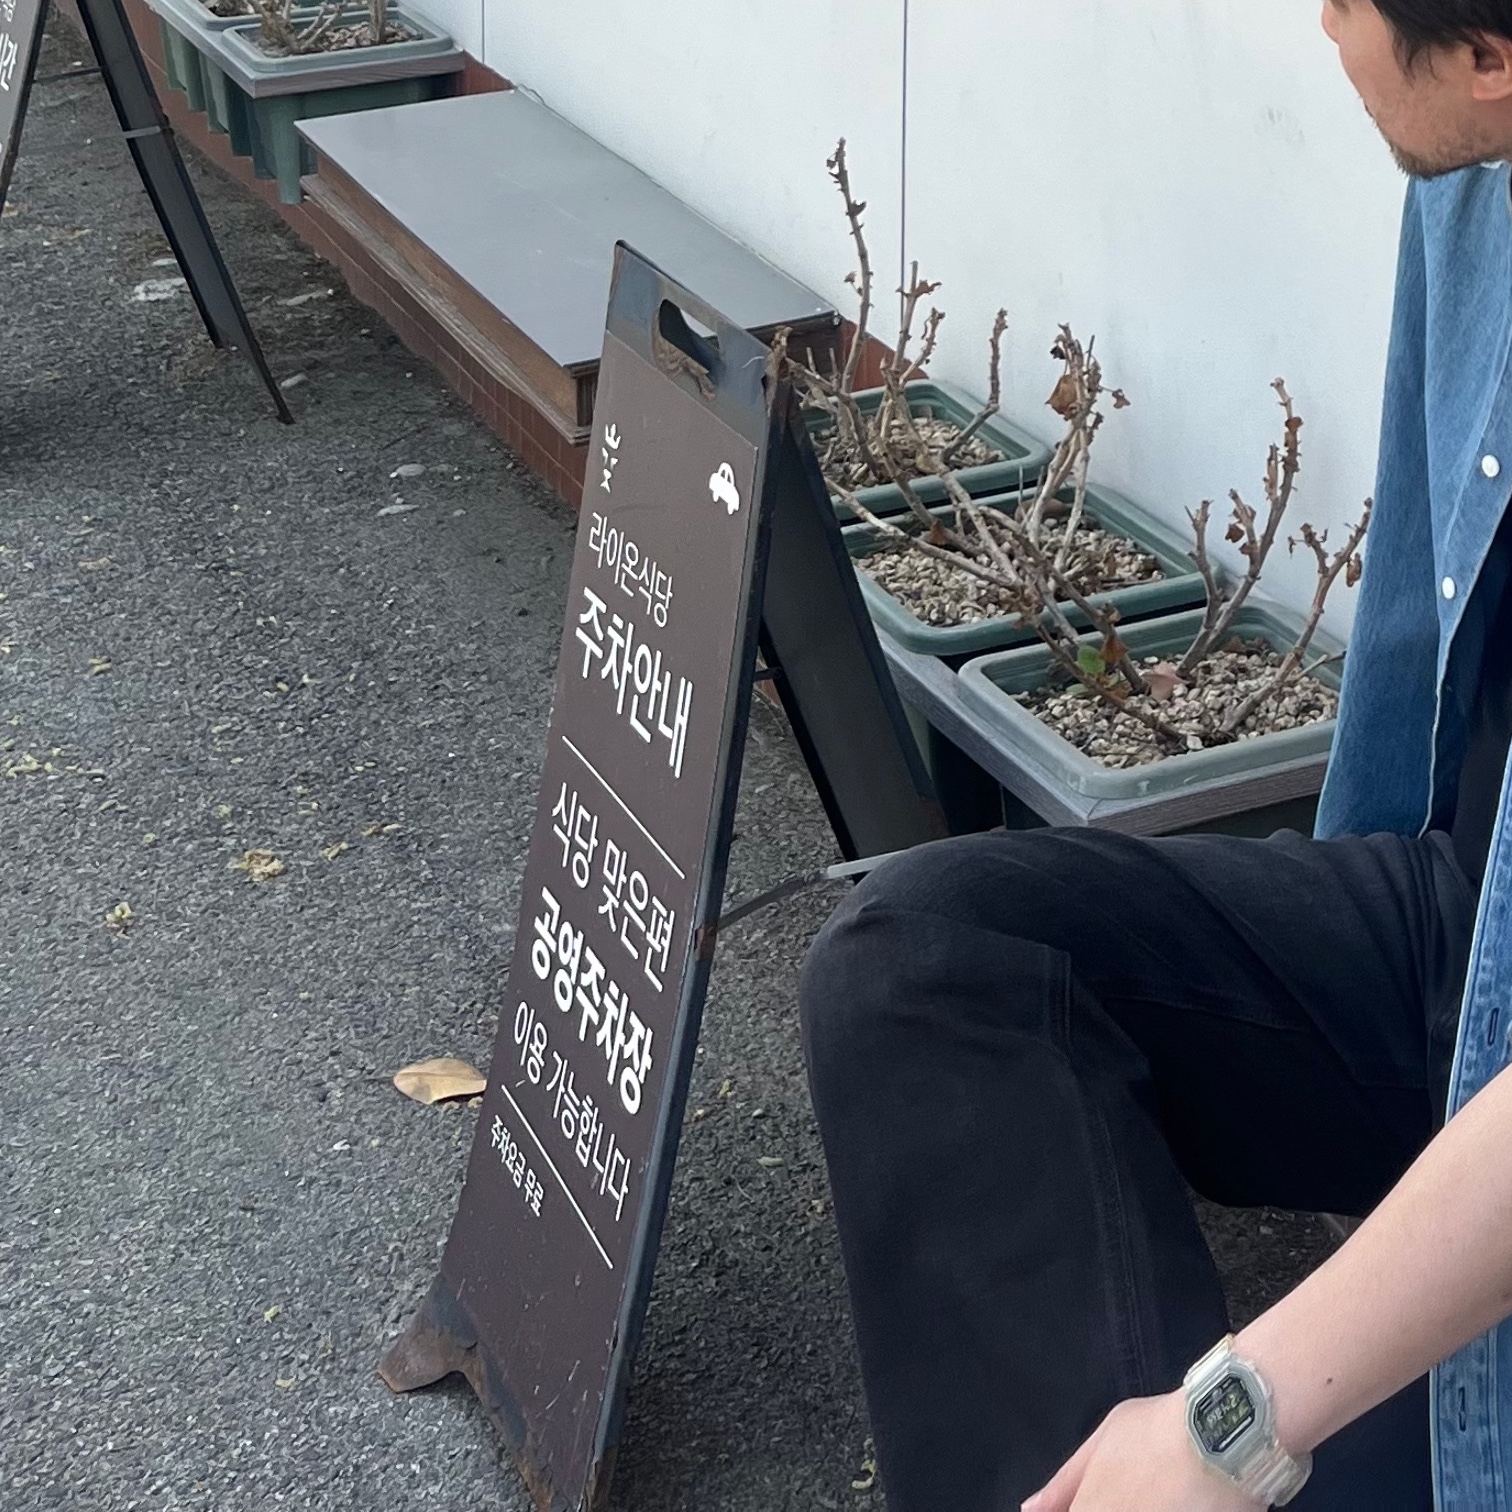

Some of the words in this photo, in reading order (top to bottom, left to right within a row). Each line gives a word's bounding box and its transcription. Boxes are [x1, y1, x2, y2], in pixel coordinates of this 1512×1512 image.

[588, 511, 674, 628] 라이온식당
[575, 585, 693, 779] 주차안내
[551, 781, 600, 890] 식당
[598, 838, 676, 994] 맞은편
[531, 886, 654, 1116] 공영주차장
[490, 1114, 527, 1190] 주차요금
[524, 1168, 545, 1218] 무료
[514, 1000, 549, 1086] 이용
[546, 1050, 632, 1223] 가능합니다
